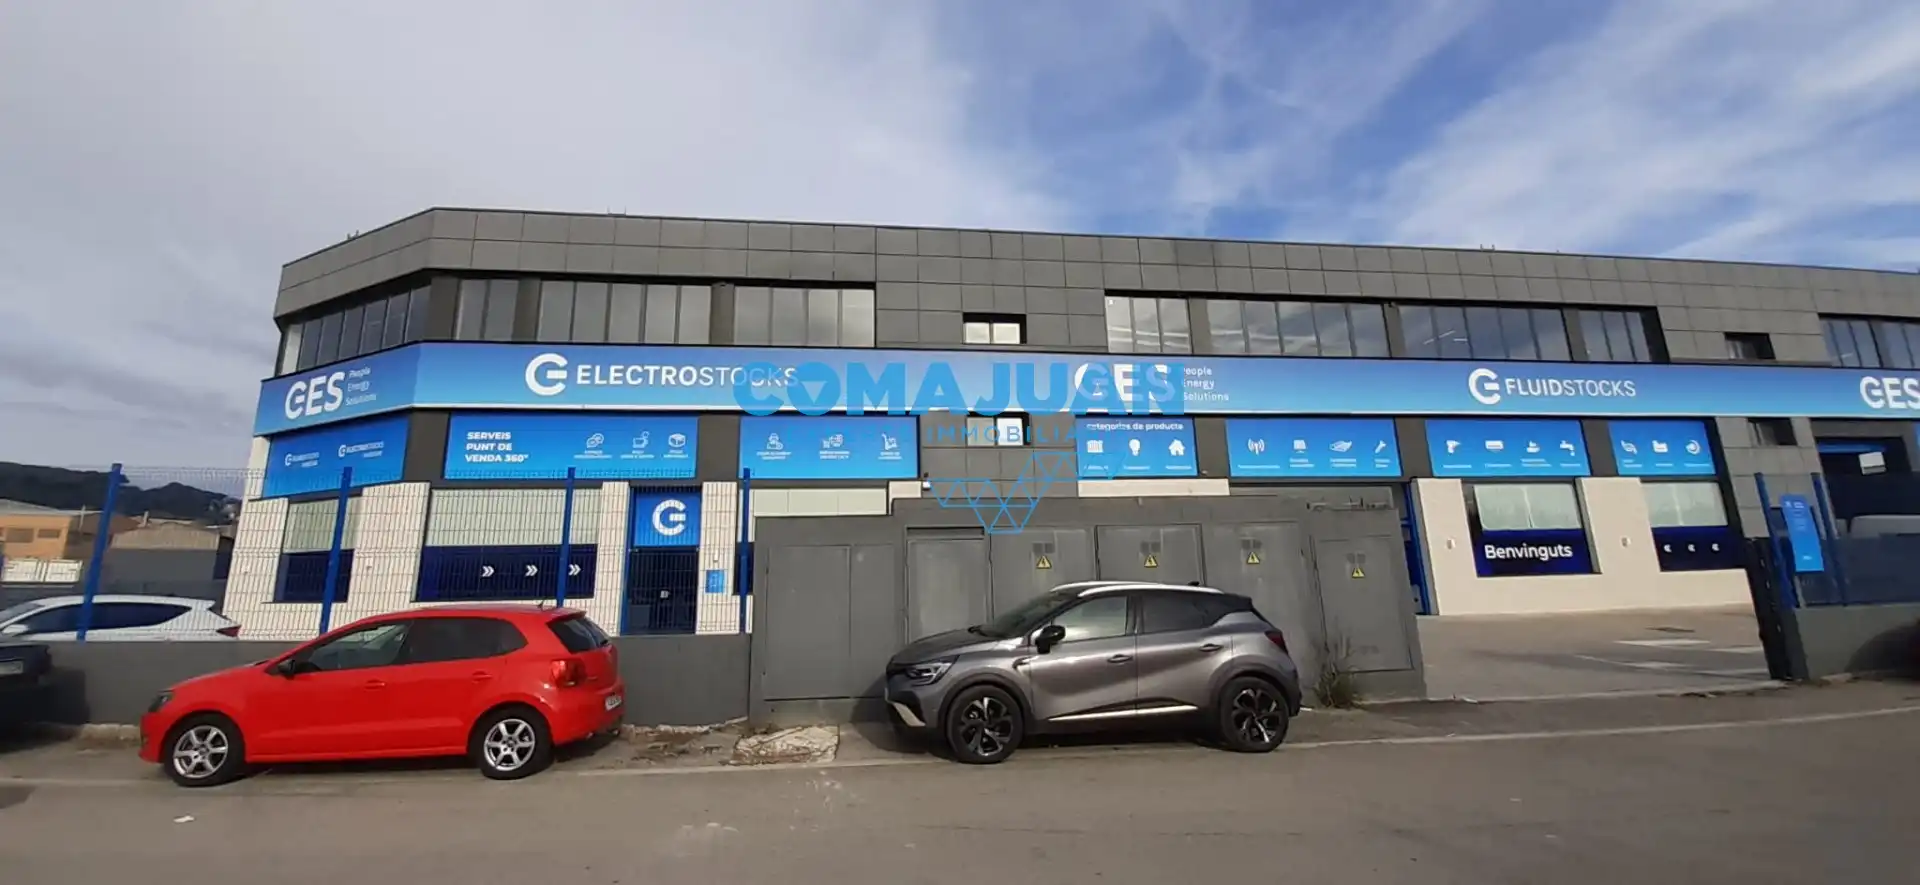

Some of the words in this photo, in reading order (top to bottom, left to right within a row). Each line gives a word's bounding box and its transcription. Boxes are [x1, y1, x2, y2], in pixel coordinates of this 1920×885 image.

[576, 363, 799, 387] ELECTROSTOCKS
[285, 371, 346, 420] GES
[1505, 377, 1636, 398] FLUIDSTOCKS
[1859, 376, 1920, 410] GES
[466, 431, 512, 440] SERVEIS
[465, 442, 497, 451] PUNT
[497, 442, 513, 451] DE
[464, 453, 503, 463] VENDA
[1484, 543, 1574, 562] Benvinguts
